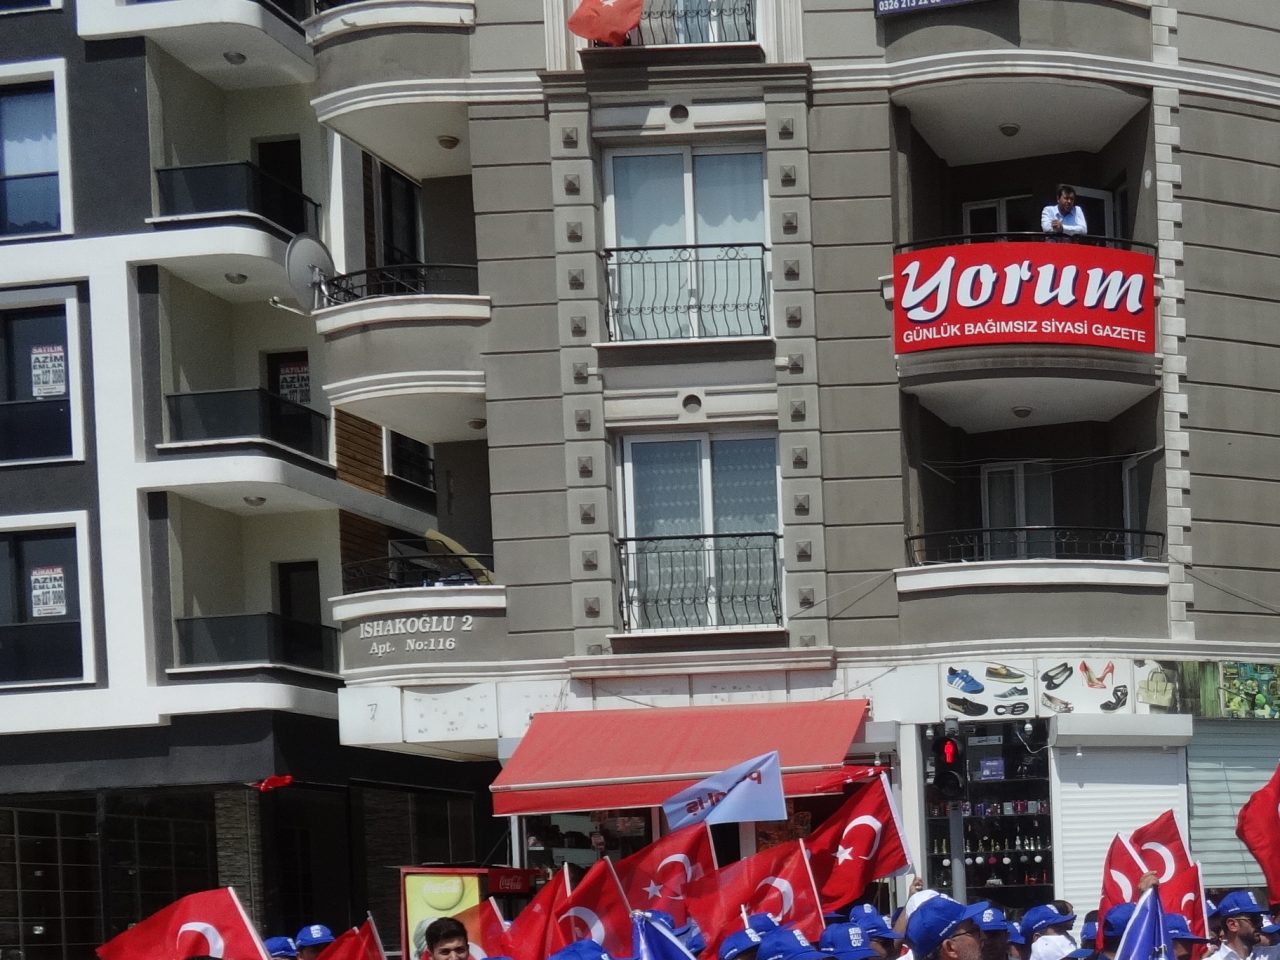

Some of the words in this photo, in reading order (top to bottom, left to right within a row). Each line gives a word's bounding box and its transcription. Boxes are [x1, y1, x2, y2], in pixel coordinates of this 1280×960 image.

[903, 322, 960, 343] GÜNLÜK
[964, 319, 1038, 334] BAĞIMSIZ
[1041, 318, 1088, 334] SİYASİ
[1092, 324, 1146, 343] GAZETE
[462, 615, 473, 631] 2
[369, 641, 396, 657] Apt.
[406, 638, 456, 650] No:116
